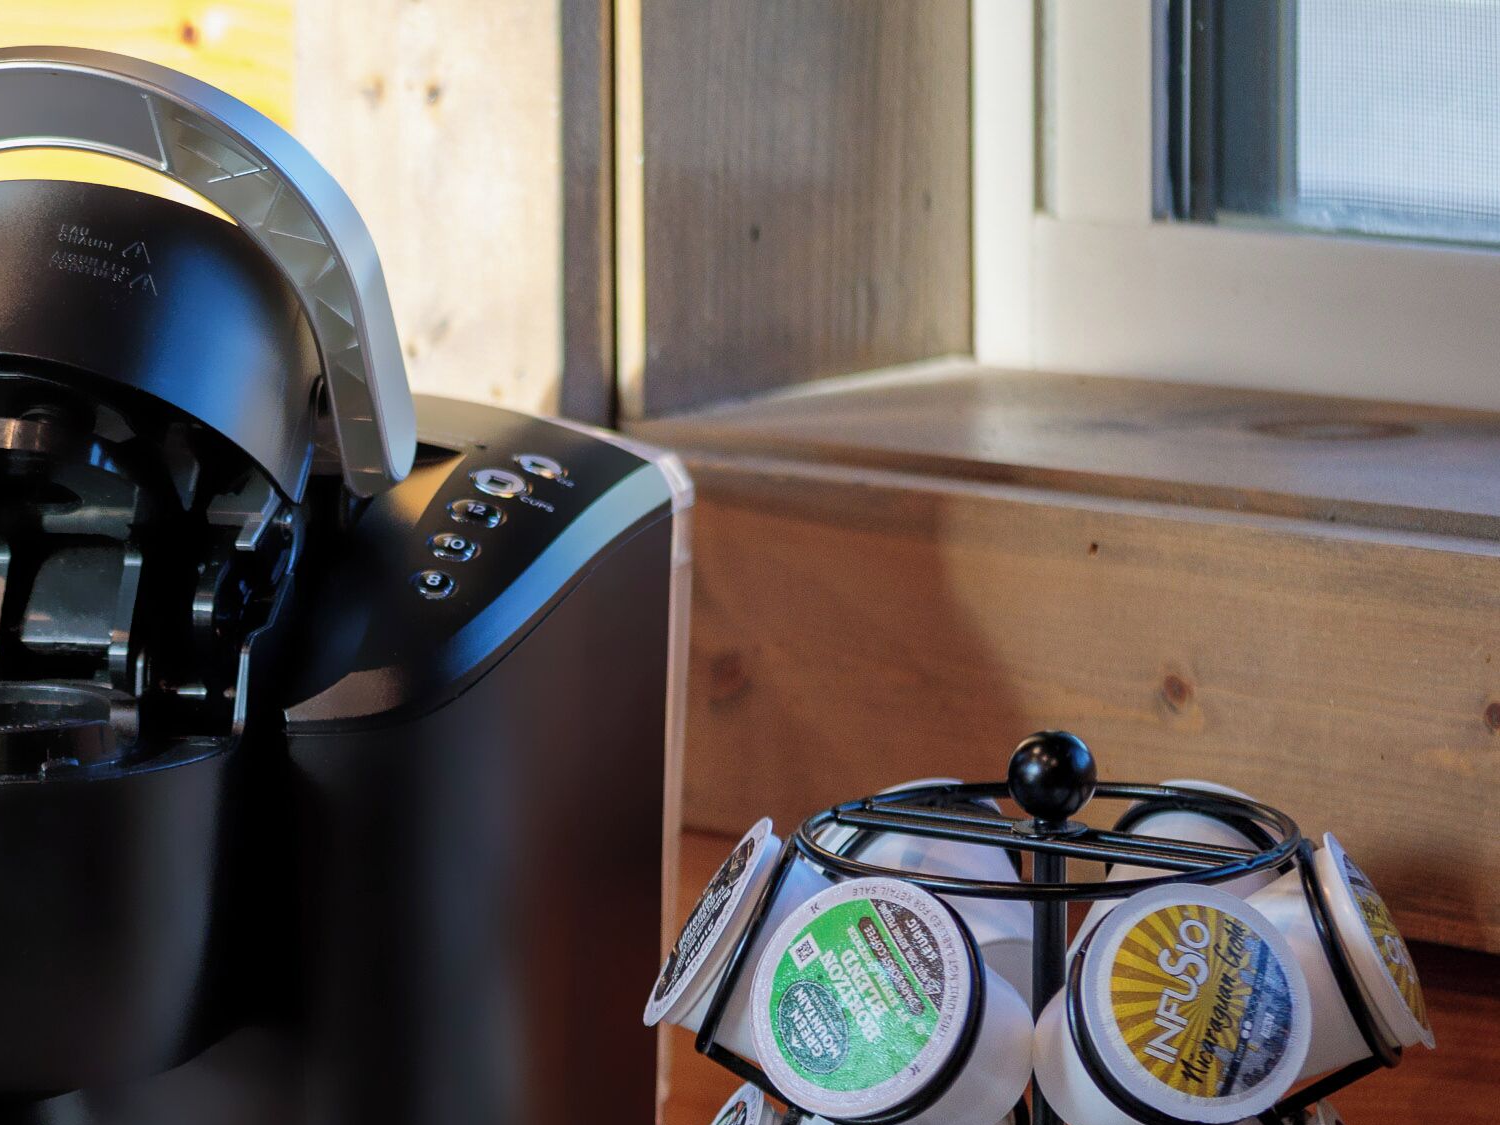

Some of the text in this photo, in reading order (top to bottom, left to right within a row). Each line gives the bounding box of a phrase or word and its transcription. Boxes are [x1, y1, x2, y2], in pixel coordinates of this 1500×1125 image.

[467, 503, 486, 516] 12
[520, 495, 556, 513] CUPS
[443, 538, 466, 550] 10
[426, 574, 442, 586] 8
[852, 886, 876, 897] SALE
[863, 923, 886, 957] COFFEE
[906, 918, 938, 962] KEURIG
[818, 949, 883, 1044] HORIZON
[840, 948, 890, 1018] BLEND
[1144, 919, 1211, 1064] INFUSIO
[1180, 919, 1246, 1084] Nicaraguan Gold
[788, 1010, 824, 1057] GREEN
[794, 986, 842, 1059] MOUNTAIN
